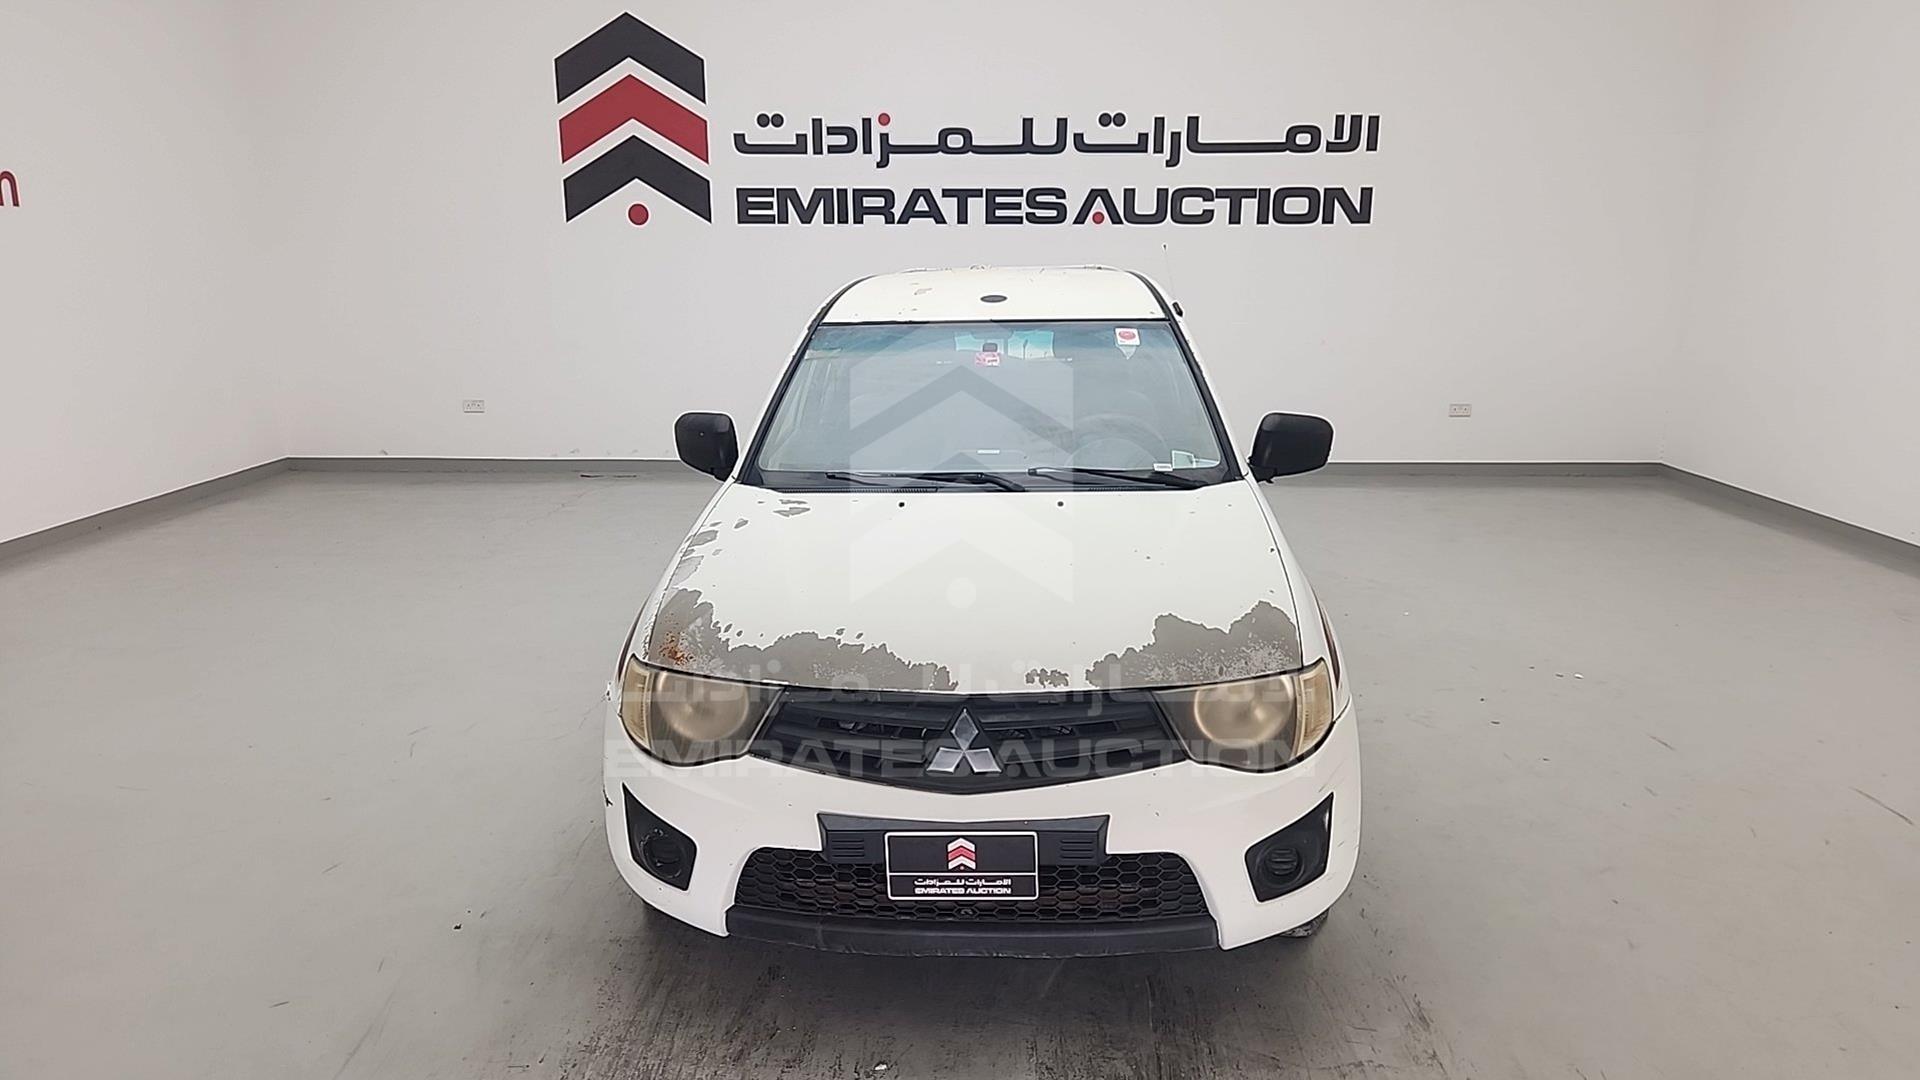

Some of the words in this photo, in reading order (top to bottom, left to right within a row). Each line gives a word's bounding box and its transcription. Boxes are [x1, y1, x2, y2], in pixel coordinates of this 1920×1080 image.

[733, 111, 1068, 169] للمزادات
[1073, 111, 1380, 168] الامارات
[735, 187, 1068, 225] EMIRATES
[1072, 186, 1374, 225] AUCTION
[914, 887, 965, 895] EMIRATES
[966, 887, 1012, 895] AUCTION
